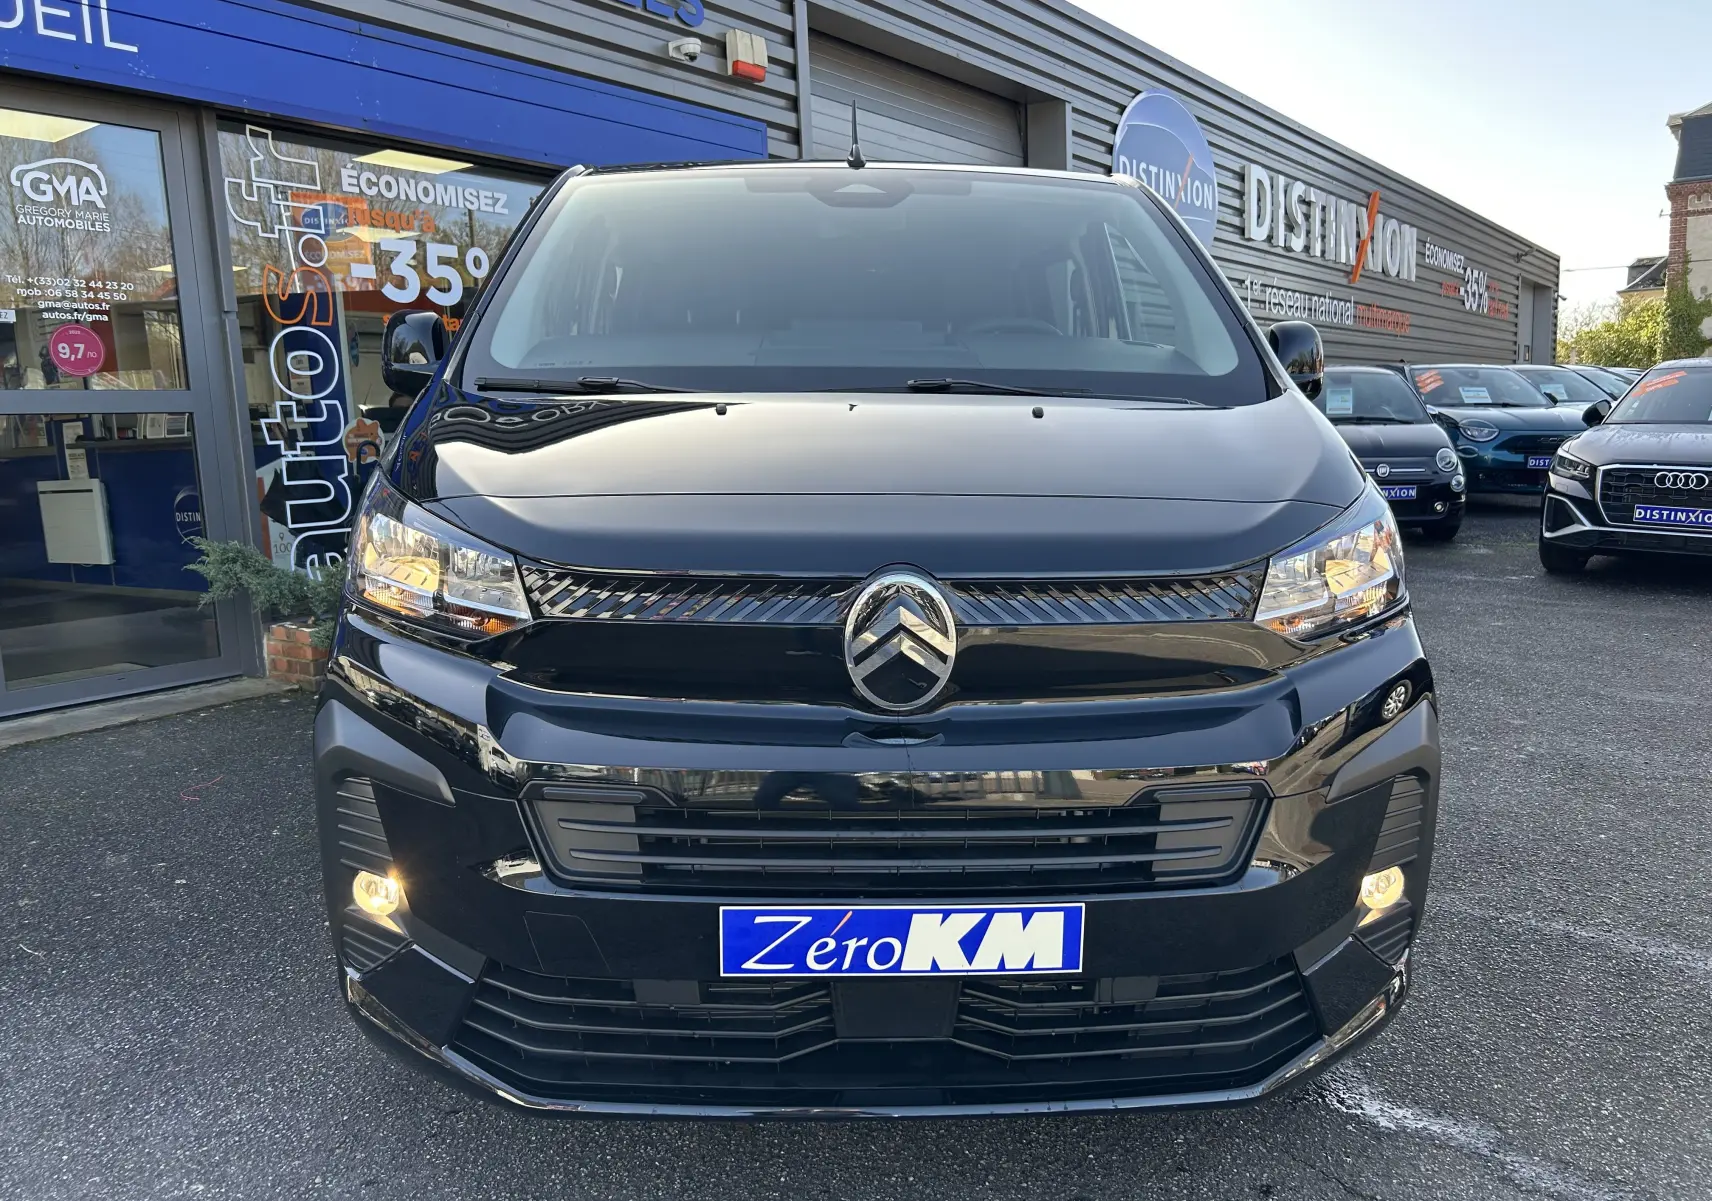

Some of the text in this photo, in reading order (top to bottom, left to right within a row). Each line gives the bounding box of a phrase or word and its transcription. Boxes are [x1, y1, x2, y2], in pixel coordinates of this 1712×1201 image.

[22, 170, 106, 208] GMA
[339, 163, 509, 214] ÉCONOMISEZ
[16, 204, 110, 222] GREGORY MARIE
[18, 214, 111, 232] AUTOMOBILES
[1244, 163, 1417, 284] DISTINXION
[1425, 237, 1465, 274] ÉCONOMISEZ
[6, 274, 134, 291] Tél. +(33)02 32 44 23 20
[16, 286, 127, 301] mob :06 58 34 45 50
[1460, 267, 1489, 314] -35%
[38, 300, 111, 311] gma@autos.fr
[1245, 274, 1262, 309] 1er
[1266, 277, 1308, 317] réseau
[1311, 290, 1354, 326] national
[42, 311, 109, 322] autos.fr/gma
[57, 343, 85, 361] 9,7
[224, 124, 353, 582] autos.fr
